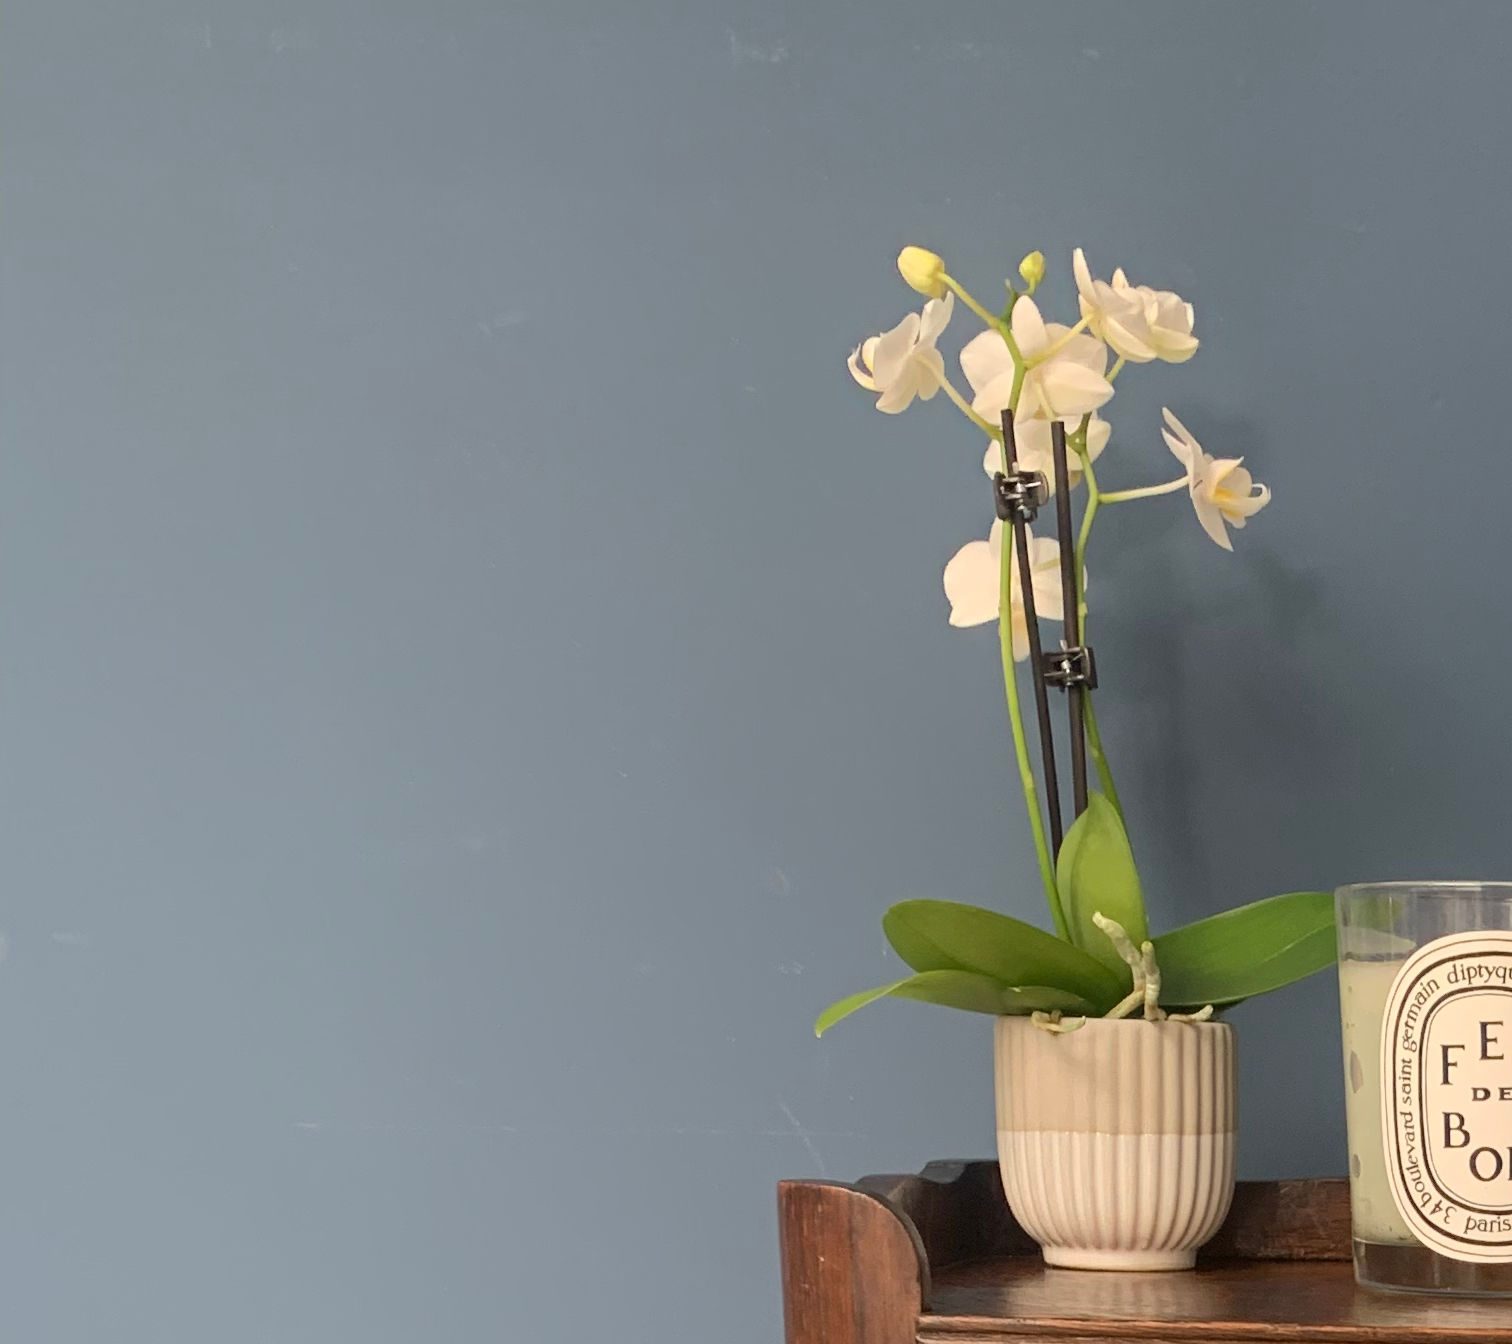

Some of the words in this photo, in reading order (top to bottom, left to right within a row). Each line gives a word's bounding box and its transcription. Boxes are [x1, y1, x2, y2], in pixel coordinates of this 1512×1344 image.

[1403, 978, 1440, 1052] germain
[1399, 1058, 1412, 1105] saint
[1400, 1111, 1432, 1208] boulevard
